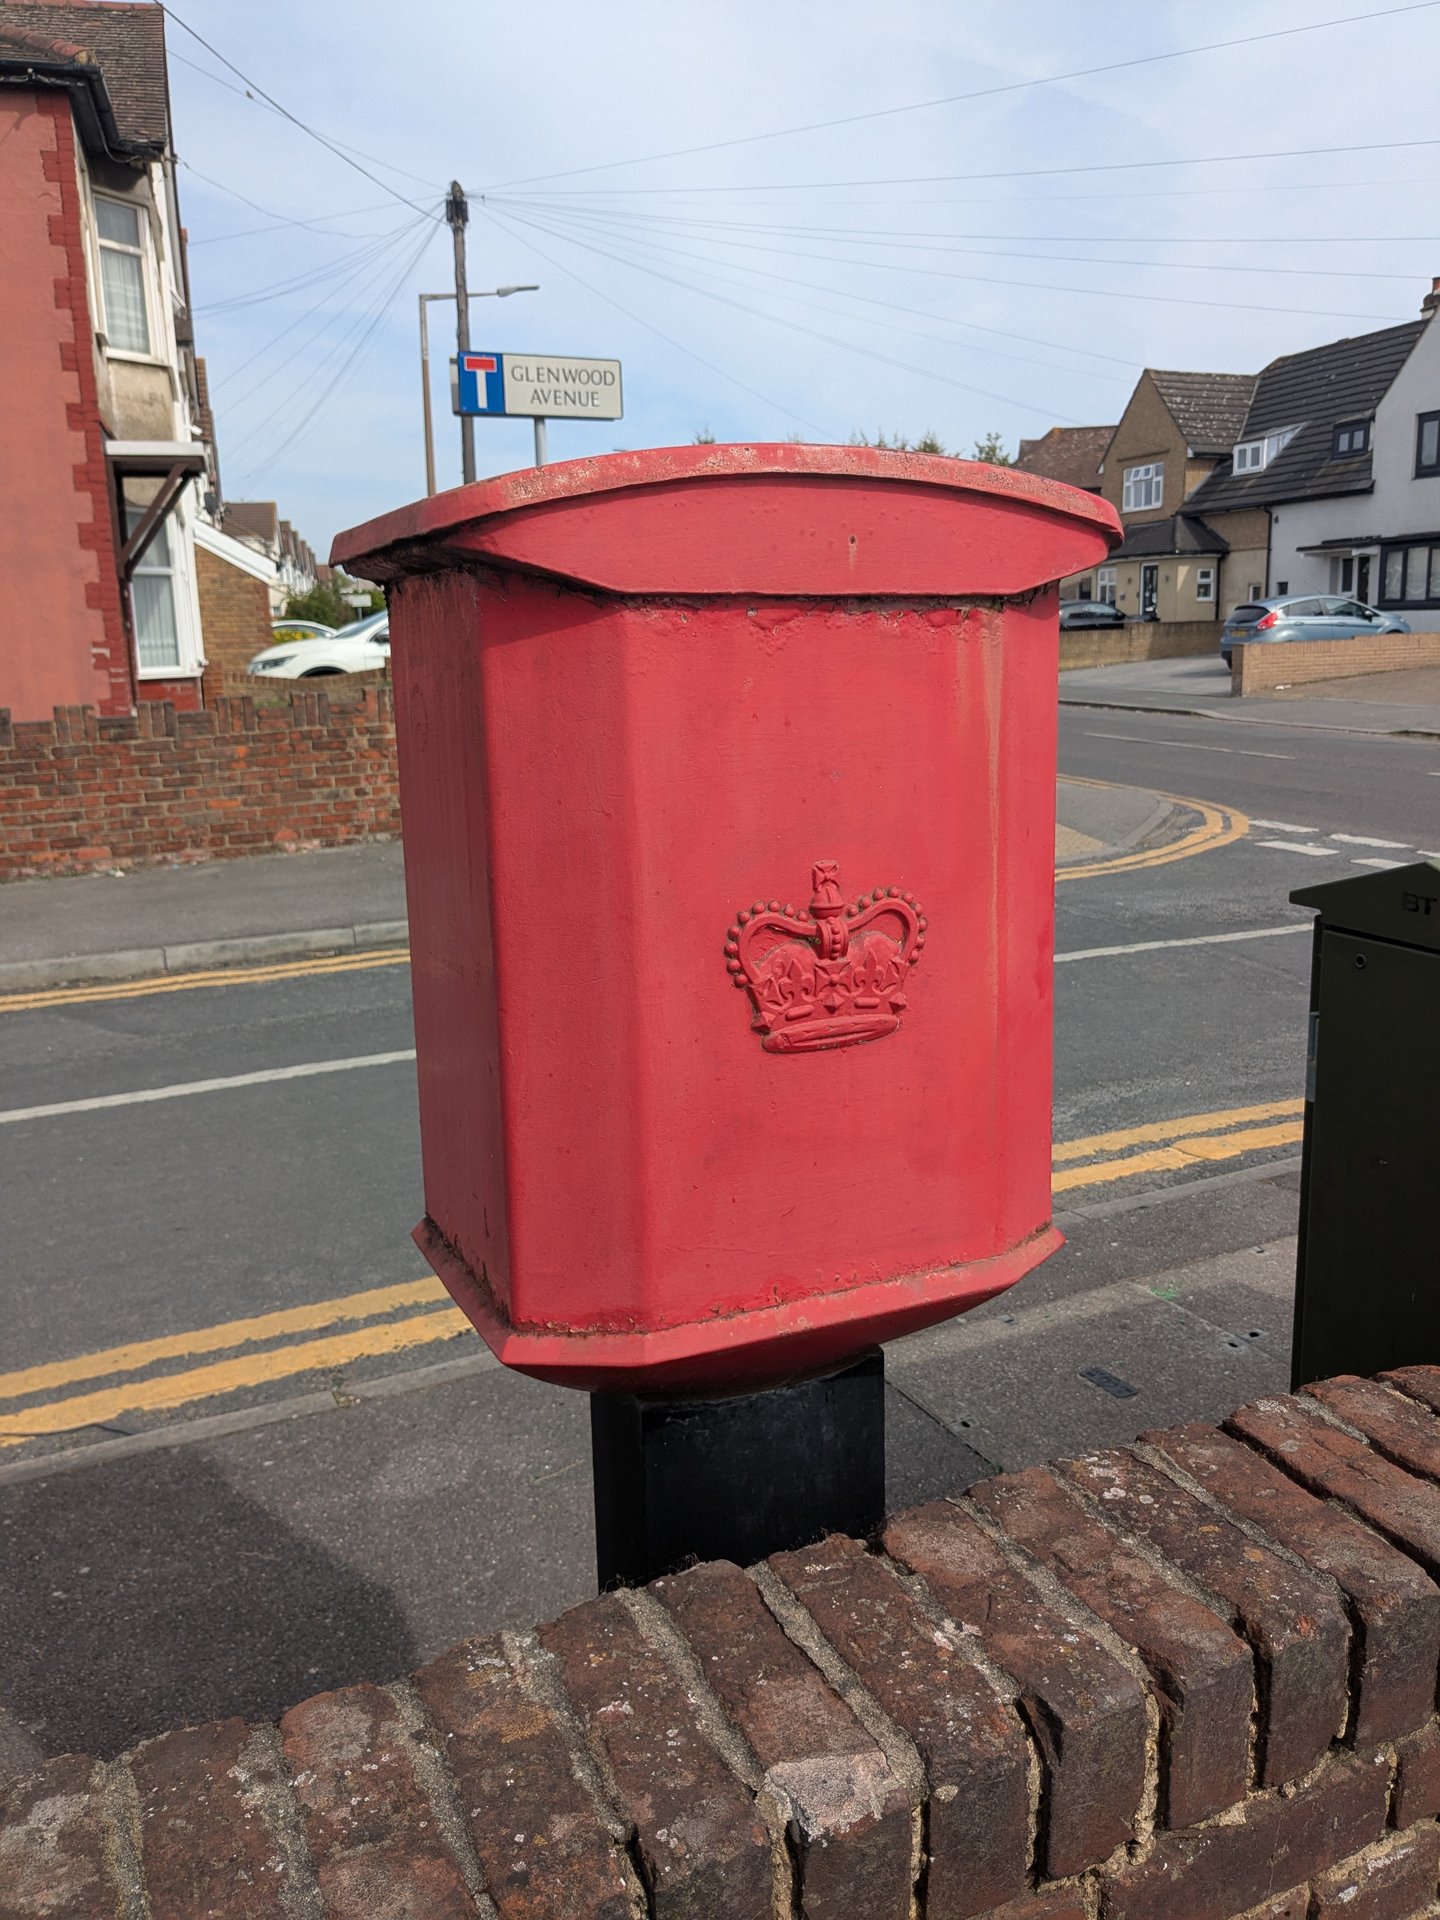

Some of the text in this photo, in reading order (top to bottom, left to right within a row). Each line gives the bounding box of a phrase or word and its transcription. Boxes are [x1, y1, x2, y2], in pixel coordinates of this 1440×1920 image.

[511, 365, 615, 386] GLENWOOD
[530, 388, 600, 407] AVENUE
[1401, 891, 1438, 916] BT
